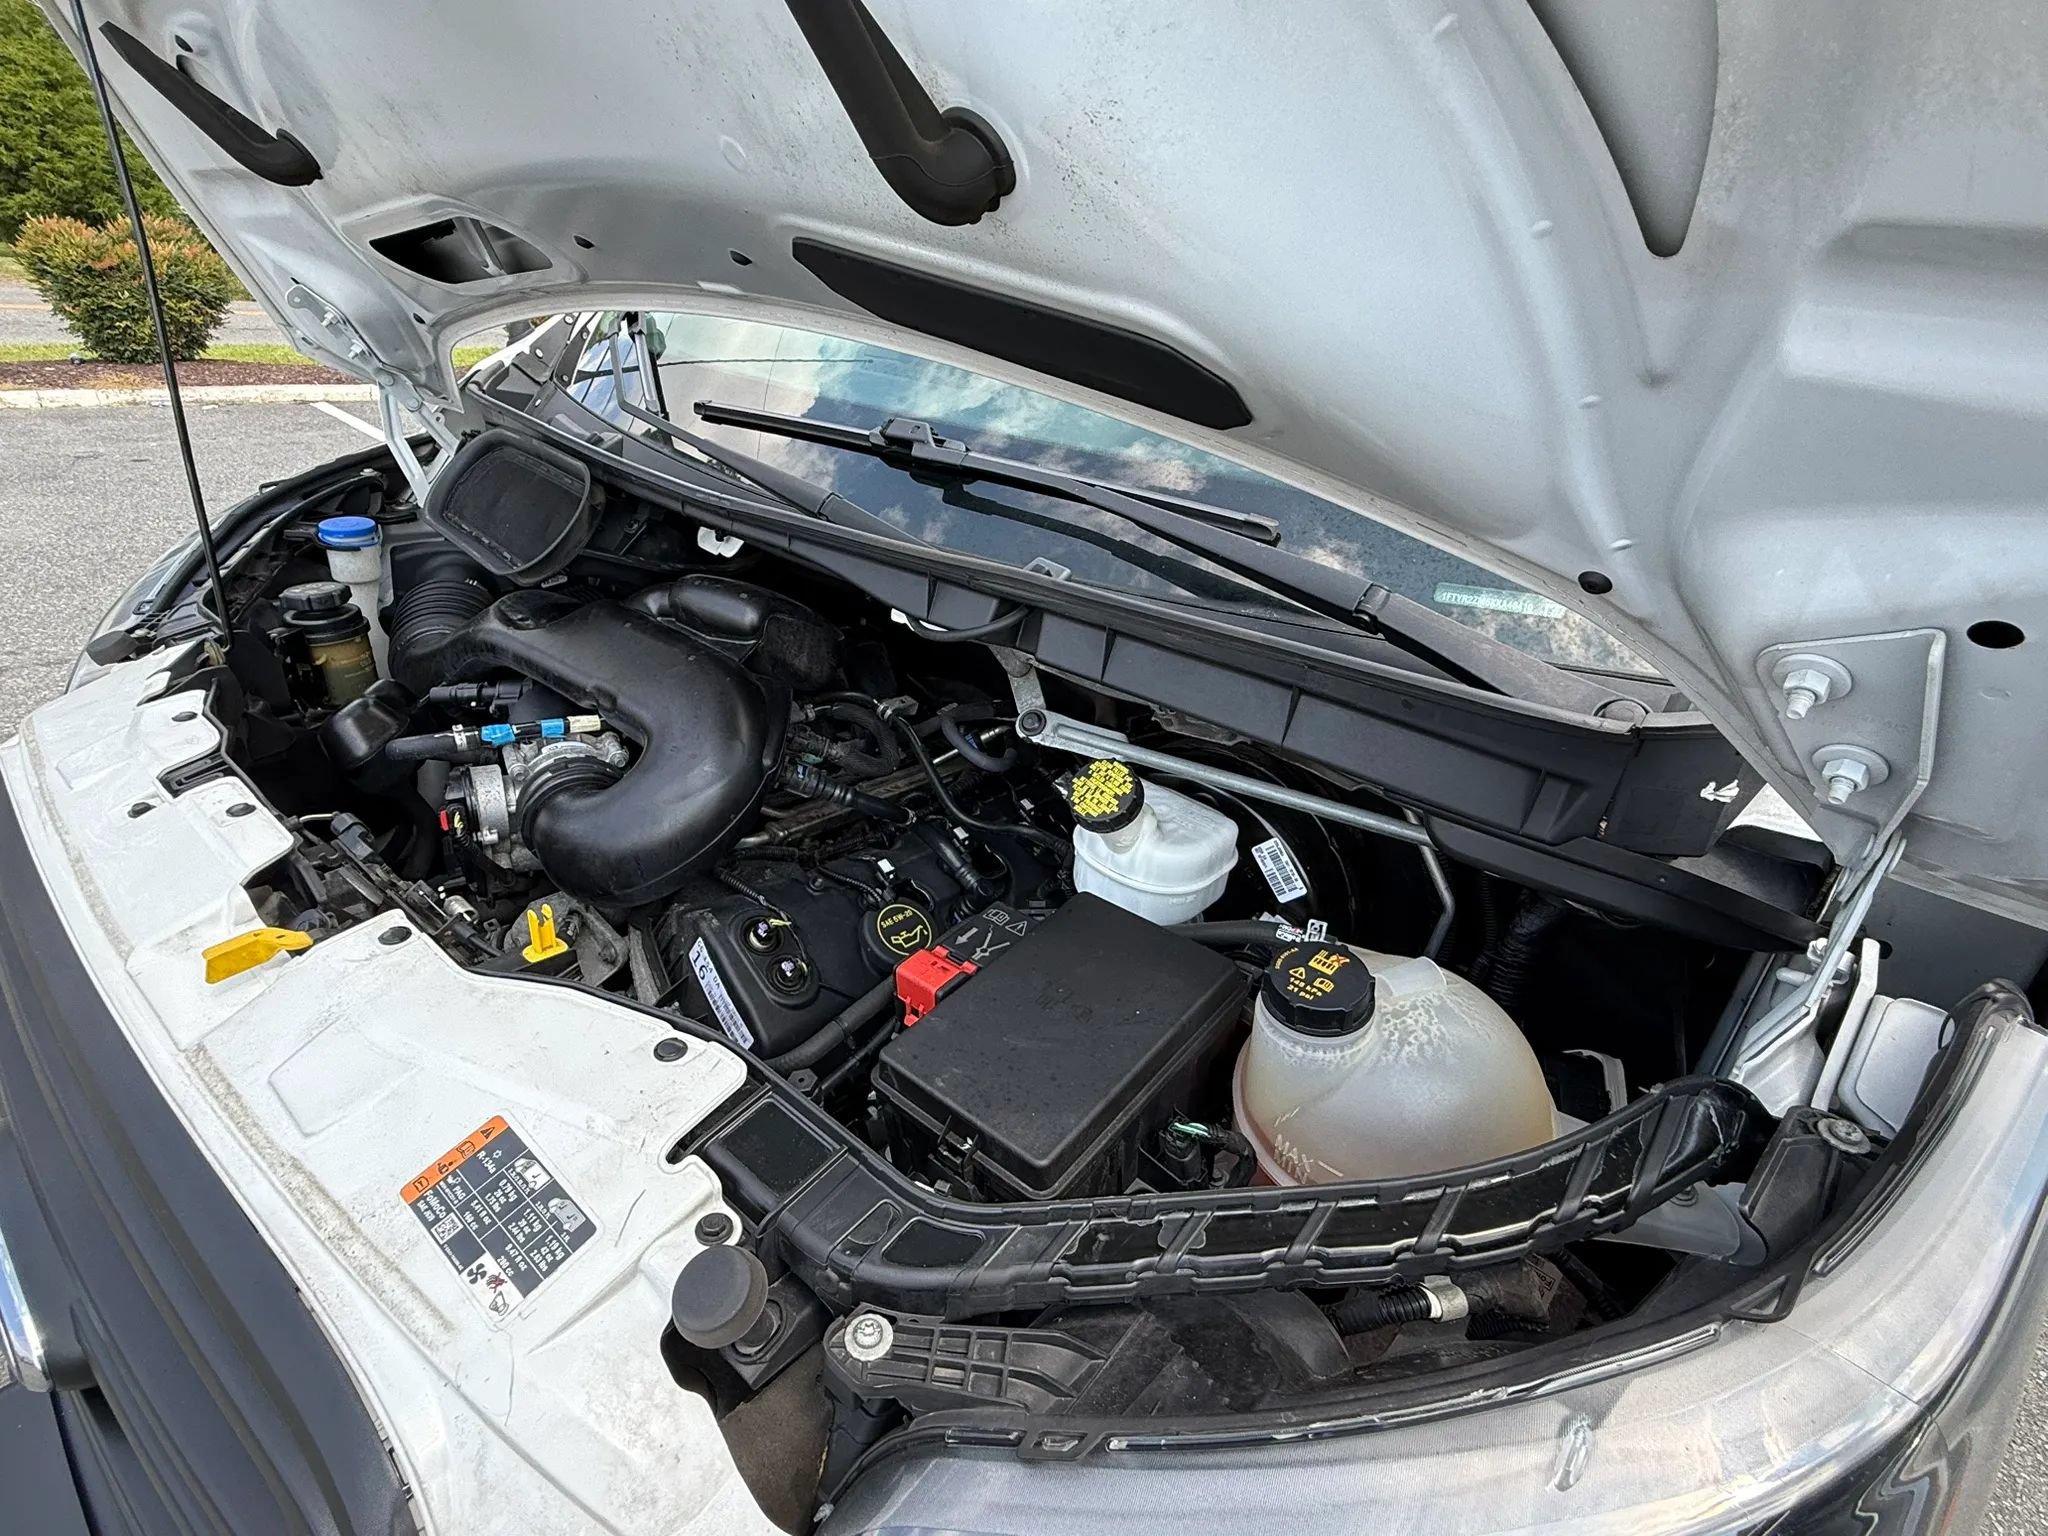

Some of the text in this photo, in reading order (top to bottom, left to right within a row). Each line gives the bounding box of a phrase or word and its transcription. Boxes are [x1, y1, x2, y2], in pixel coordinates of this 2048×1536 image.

[880, 917, 894, 928] SAE
[691, 950, 709, 981] 16
[1286, 985, 1314, 1001] 21 psi
[1305, 982, 1323, 997] kPa
[1274, 1133, 1314, 1173] MAX
[476, 1150, 496, 1174] R-134a
[452, 1185, 466, 1200] PAG
[499, 1196, 507, 1204] oz
[508, 1189, 518, 1202] kg
[423, 1189, 446, 1219] FoMoCo
[470, 1222, 479, 1230] cc
[483, 1216, 492, 1225] oz
[523, 1208, 542, 1232] 1.11 kg
[523, 1226, 531, 1234] oz
[540, 1246, 554, 1263] 42 oz
[545, 1235, 565, 1261] 1.19 kg
[505, 1267, 514, 1277] cc
[518, 1261, 528, 1271] oz
